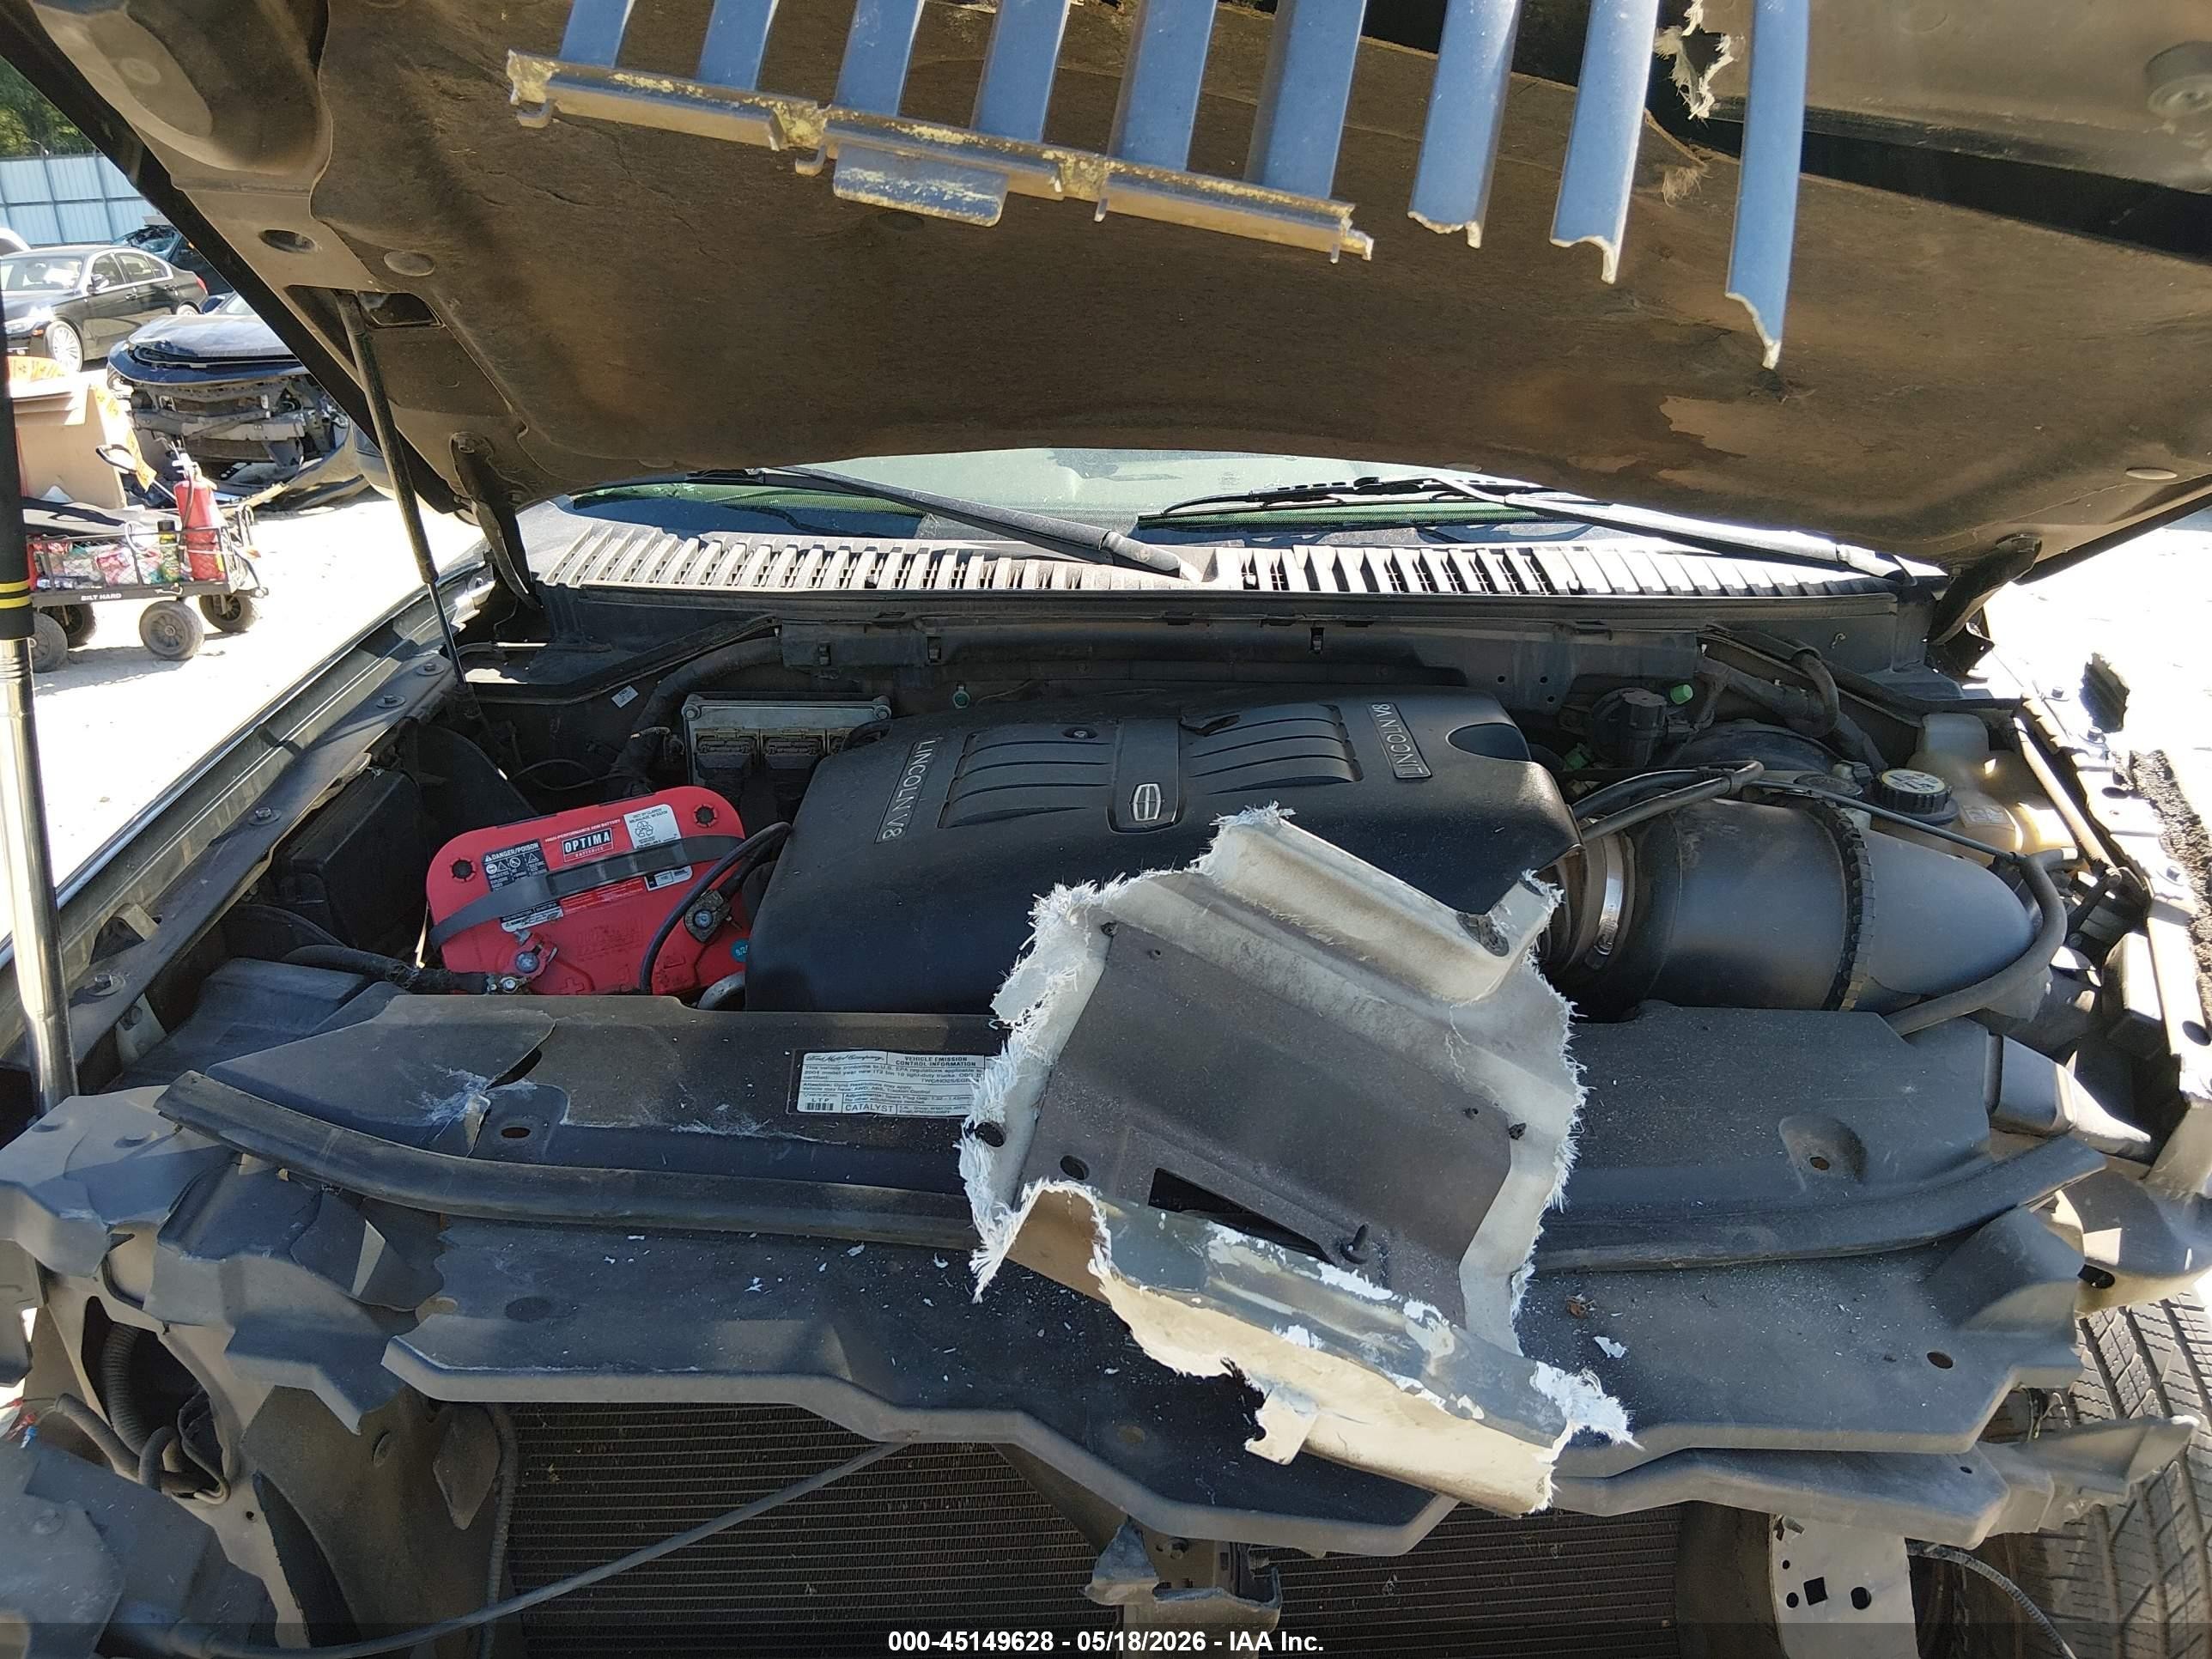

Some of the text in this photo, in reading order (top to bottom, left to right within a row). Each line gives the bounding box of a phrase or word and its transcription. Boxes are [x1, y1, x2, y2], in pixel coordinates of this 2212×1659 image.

[1371, 704, 1423, 775] LINCOLN V8
[882, 740, 936, 840] LINCOLN V8
[564, 831, 611, 853] OPTIMA
[845, 1103, 893, 1112] CATALYST
